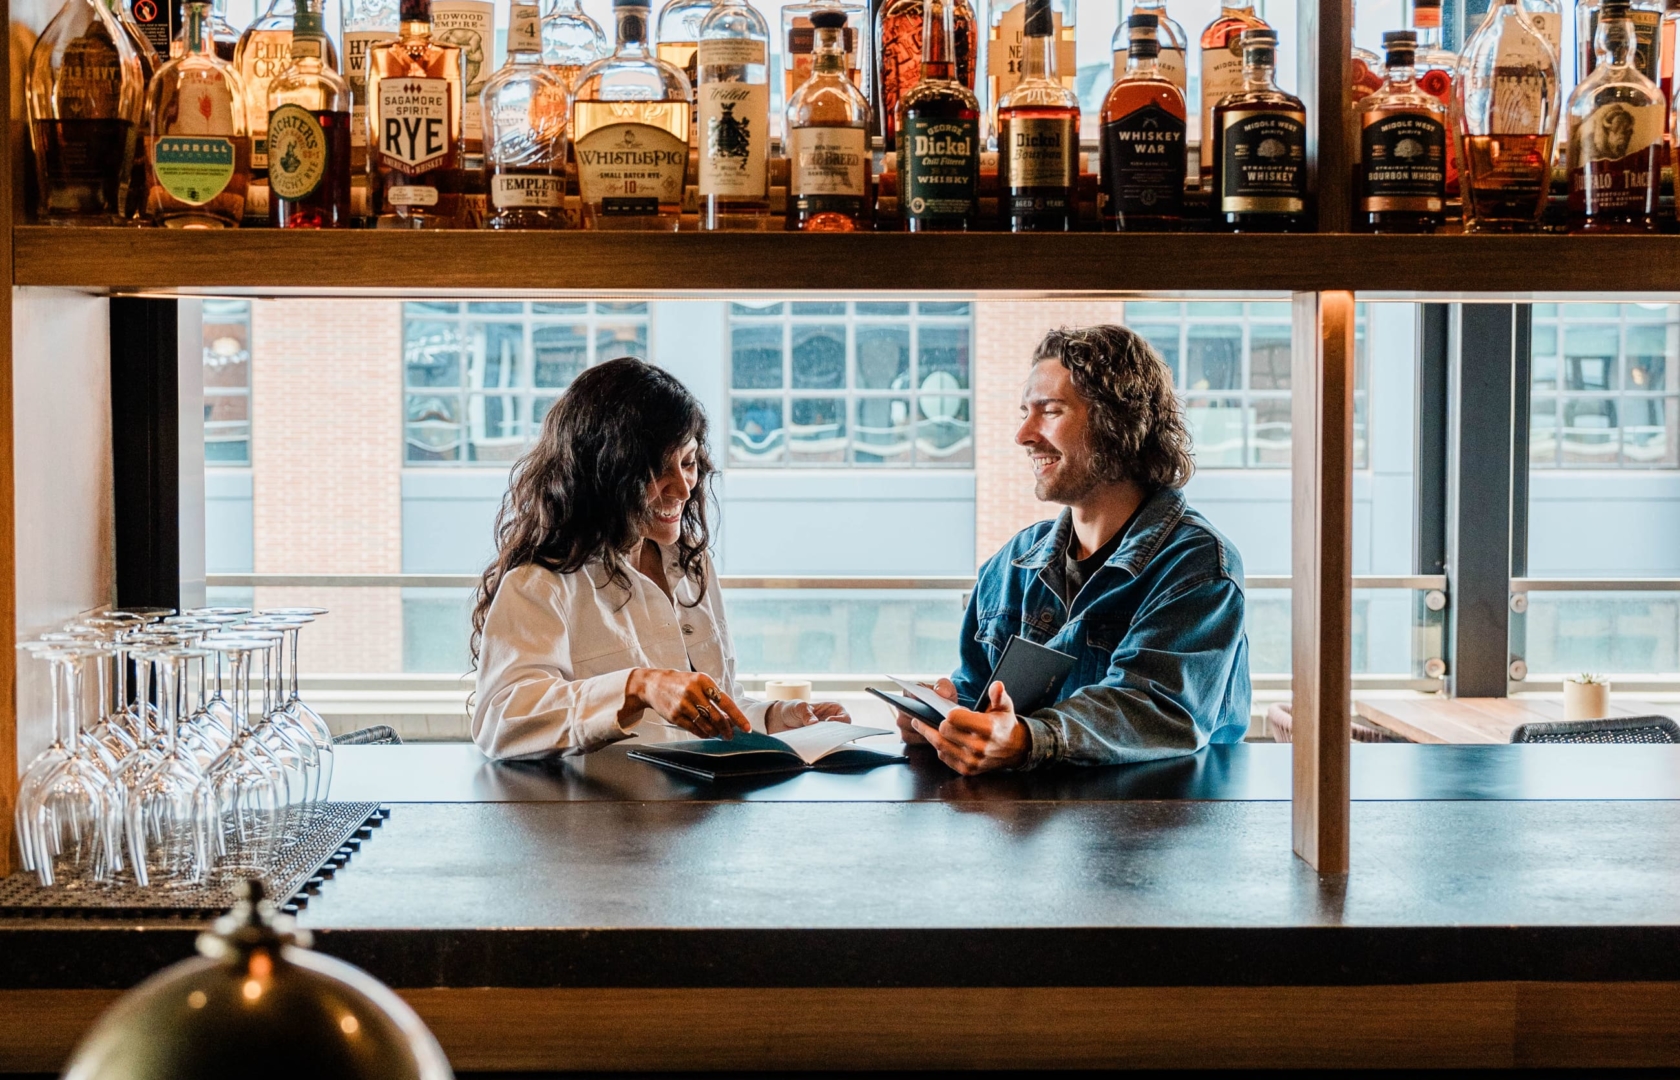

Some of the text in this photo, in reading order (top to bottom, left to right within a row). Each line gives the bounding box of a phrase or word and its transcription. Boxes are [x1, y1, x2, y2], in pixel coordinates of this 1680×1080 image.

[432, 14, 483, 22] EDWOOD
[523, 22, 535, 37] 4
[254, 41, 292, 61] ELIJA
[253, 59, 289, 78] CRA
[710, 87, 751, 100] Willett
[384, 96, 443, 106] SAGAMORE
[396, 107, 430, 116] SPIRIT
[927, 124, 963, 136] GEORGE
[1244, 120, 1298, 133] MIDDLE WEST
[1380, 120, 1436, 132] MIDDLE WEST
[385, 117, 443, 161] RYE
[1016, 132, 1061, 147] Dickel
[1119, 131, 1181, 141] WHISKEY
[162, 143, 227, 154] BARRELL
[915, 135, 971, 157] Dickel
[1134, 144, 1166, 154] WAR
[579, 149, 683, 167] WHISTLEPIG
[1015, 149, 1062, 160] Bourbon
[383, 155, 444, 175] AMERICAN WHISKEY
[922, 157, 966, 166] Chill Filtered
[304, 160, 319, 180] RYE
[1247, 172, 1294, 181] WHISKEY
[1368, 172, 1442, 181] BOURBON WHISKEY
[500, 178, 563, 192] TEMPLETO
[917, 176, 969, 184] WHISKY
[1573, 172, 1612, 192] BUALO
[624, 181, 637, 194] 10
